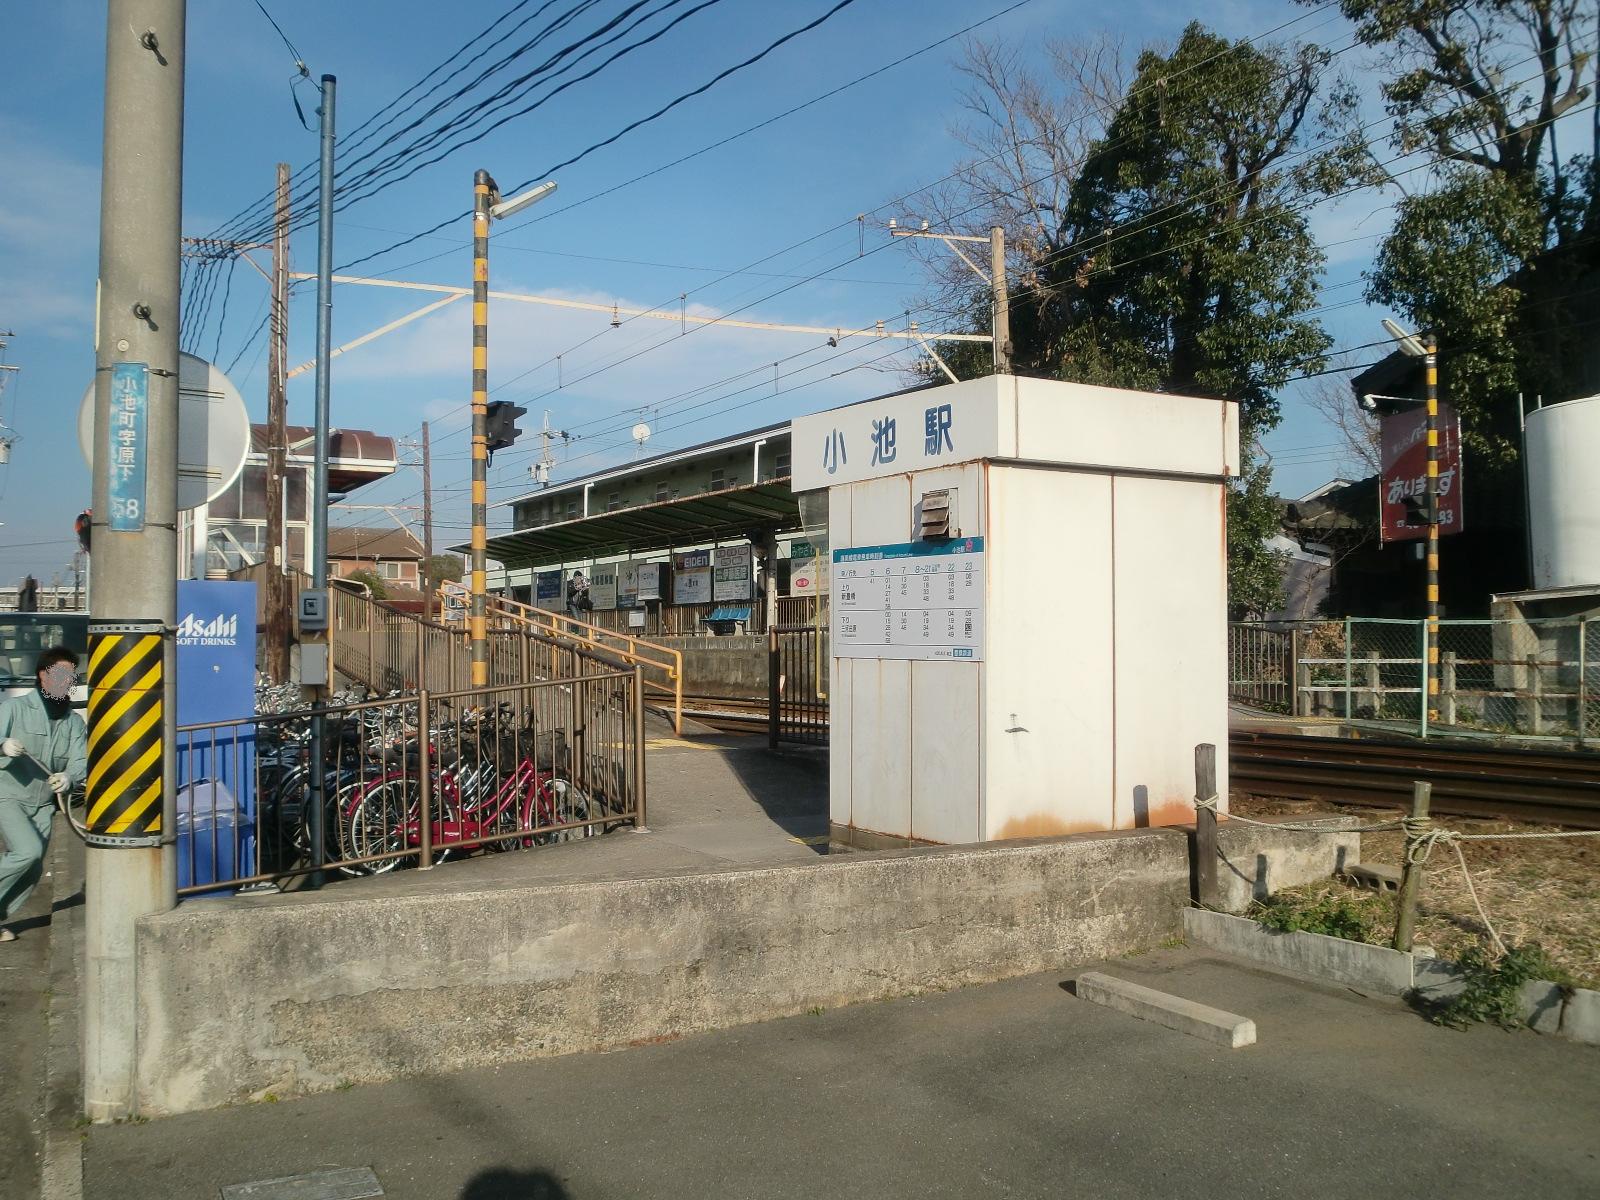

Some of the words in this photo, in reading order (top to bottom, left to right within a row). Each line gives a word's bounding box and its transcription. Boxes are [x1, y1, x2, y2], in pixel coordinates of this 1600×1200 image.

[117, 376, 136, 480] 小池町字原下
[823, 403, 953, 475] 小池駅
[684, 555, 708, 567] EIDEN
[870, 568, 875, 576] 5
[885, 567, 891, 575] 6
[901, 566, 907, 574] 7
[948, 563, 955, 571] 22
[965, 562, 973, 570] 23
[176, 613, 237, 637] Asahi
[841, 616, 850, 624] 下り
